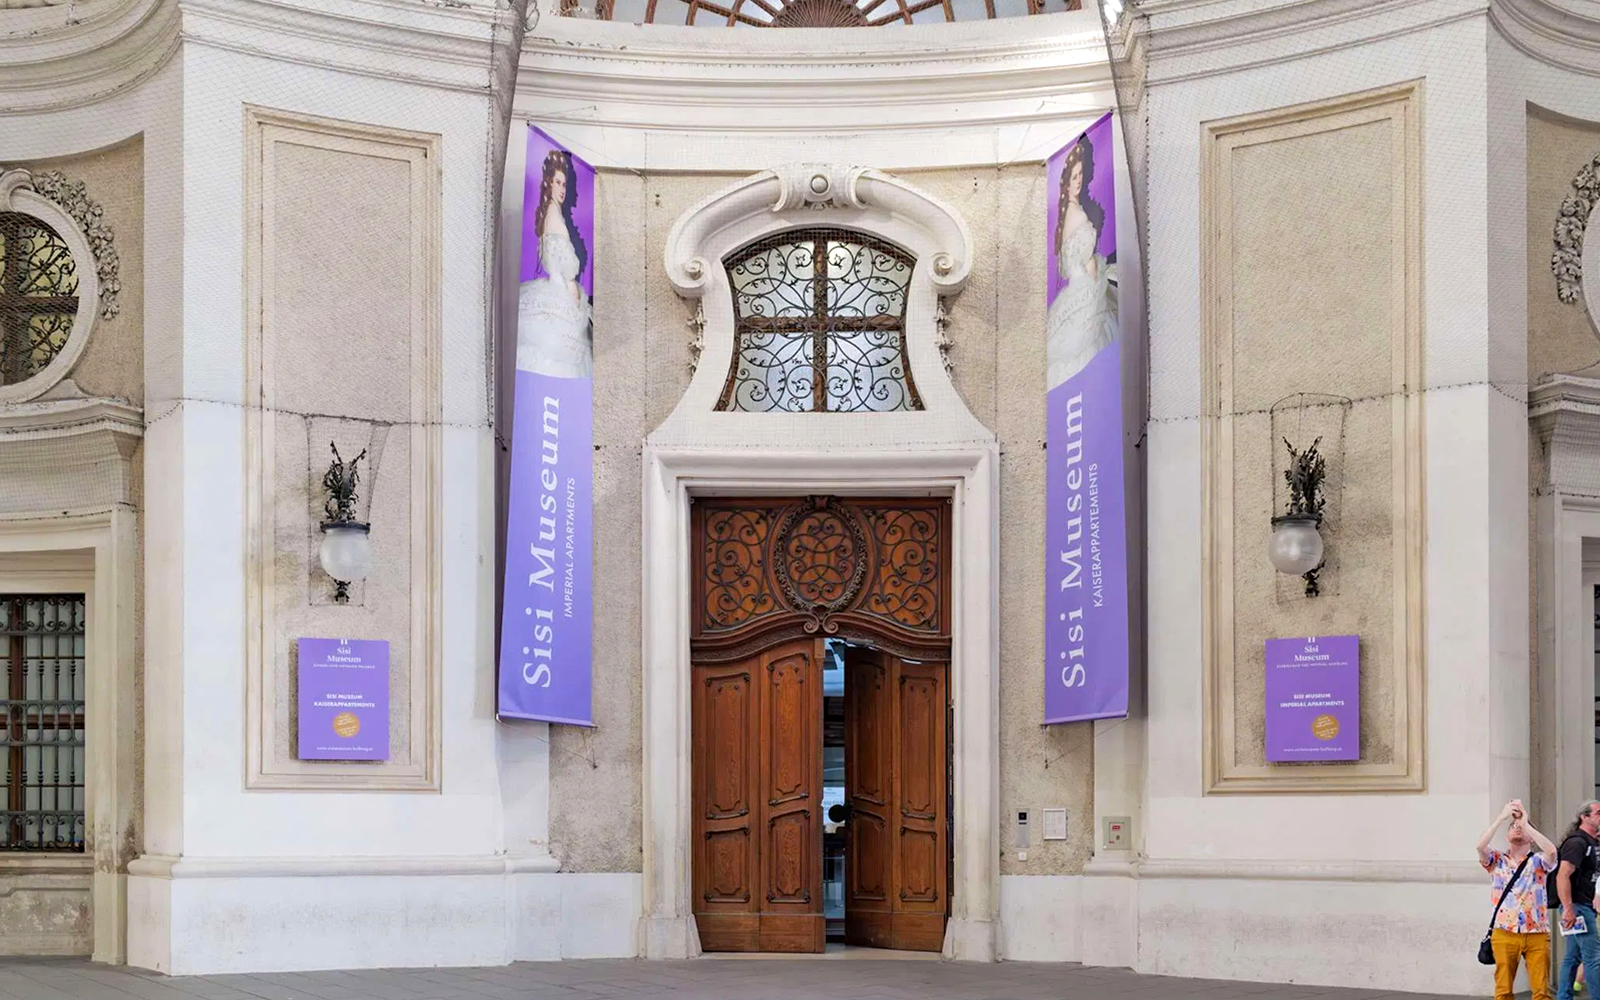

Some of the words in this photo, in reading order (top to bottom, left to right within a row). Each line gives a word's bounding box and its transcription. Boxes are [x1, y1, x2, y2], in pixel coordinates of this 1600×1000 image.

[528, 395, 559, 591] Museum
[565, 477, 576, 559] APARTMENTS
[1060, 391, 1083, 592] Museum
[1090, 463, 1103, 608] KAISERAPPARTEMENTS
[563, 562, 575, 618] IMPERIAL
[327, 655, 362, 663] Museum
[337, 647, 351, 655] Sisi
[522, 607, 553, 688] Sisi
[1060, 606, 1085, 688] Sisi
[1294, 654, 1330, 662] Museum
[1304, 645, 1319, 653] Sisi
